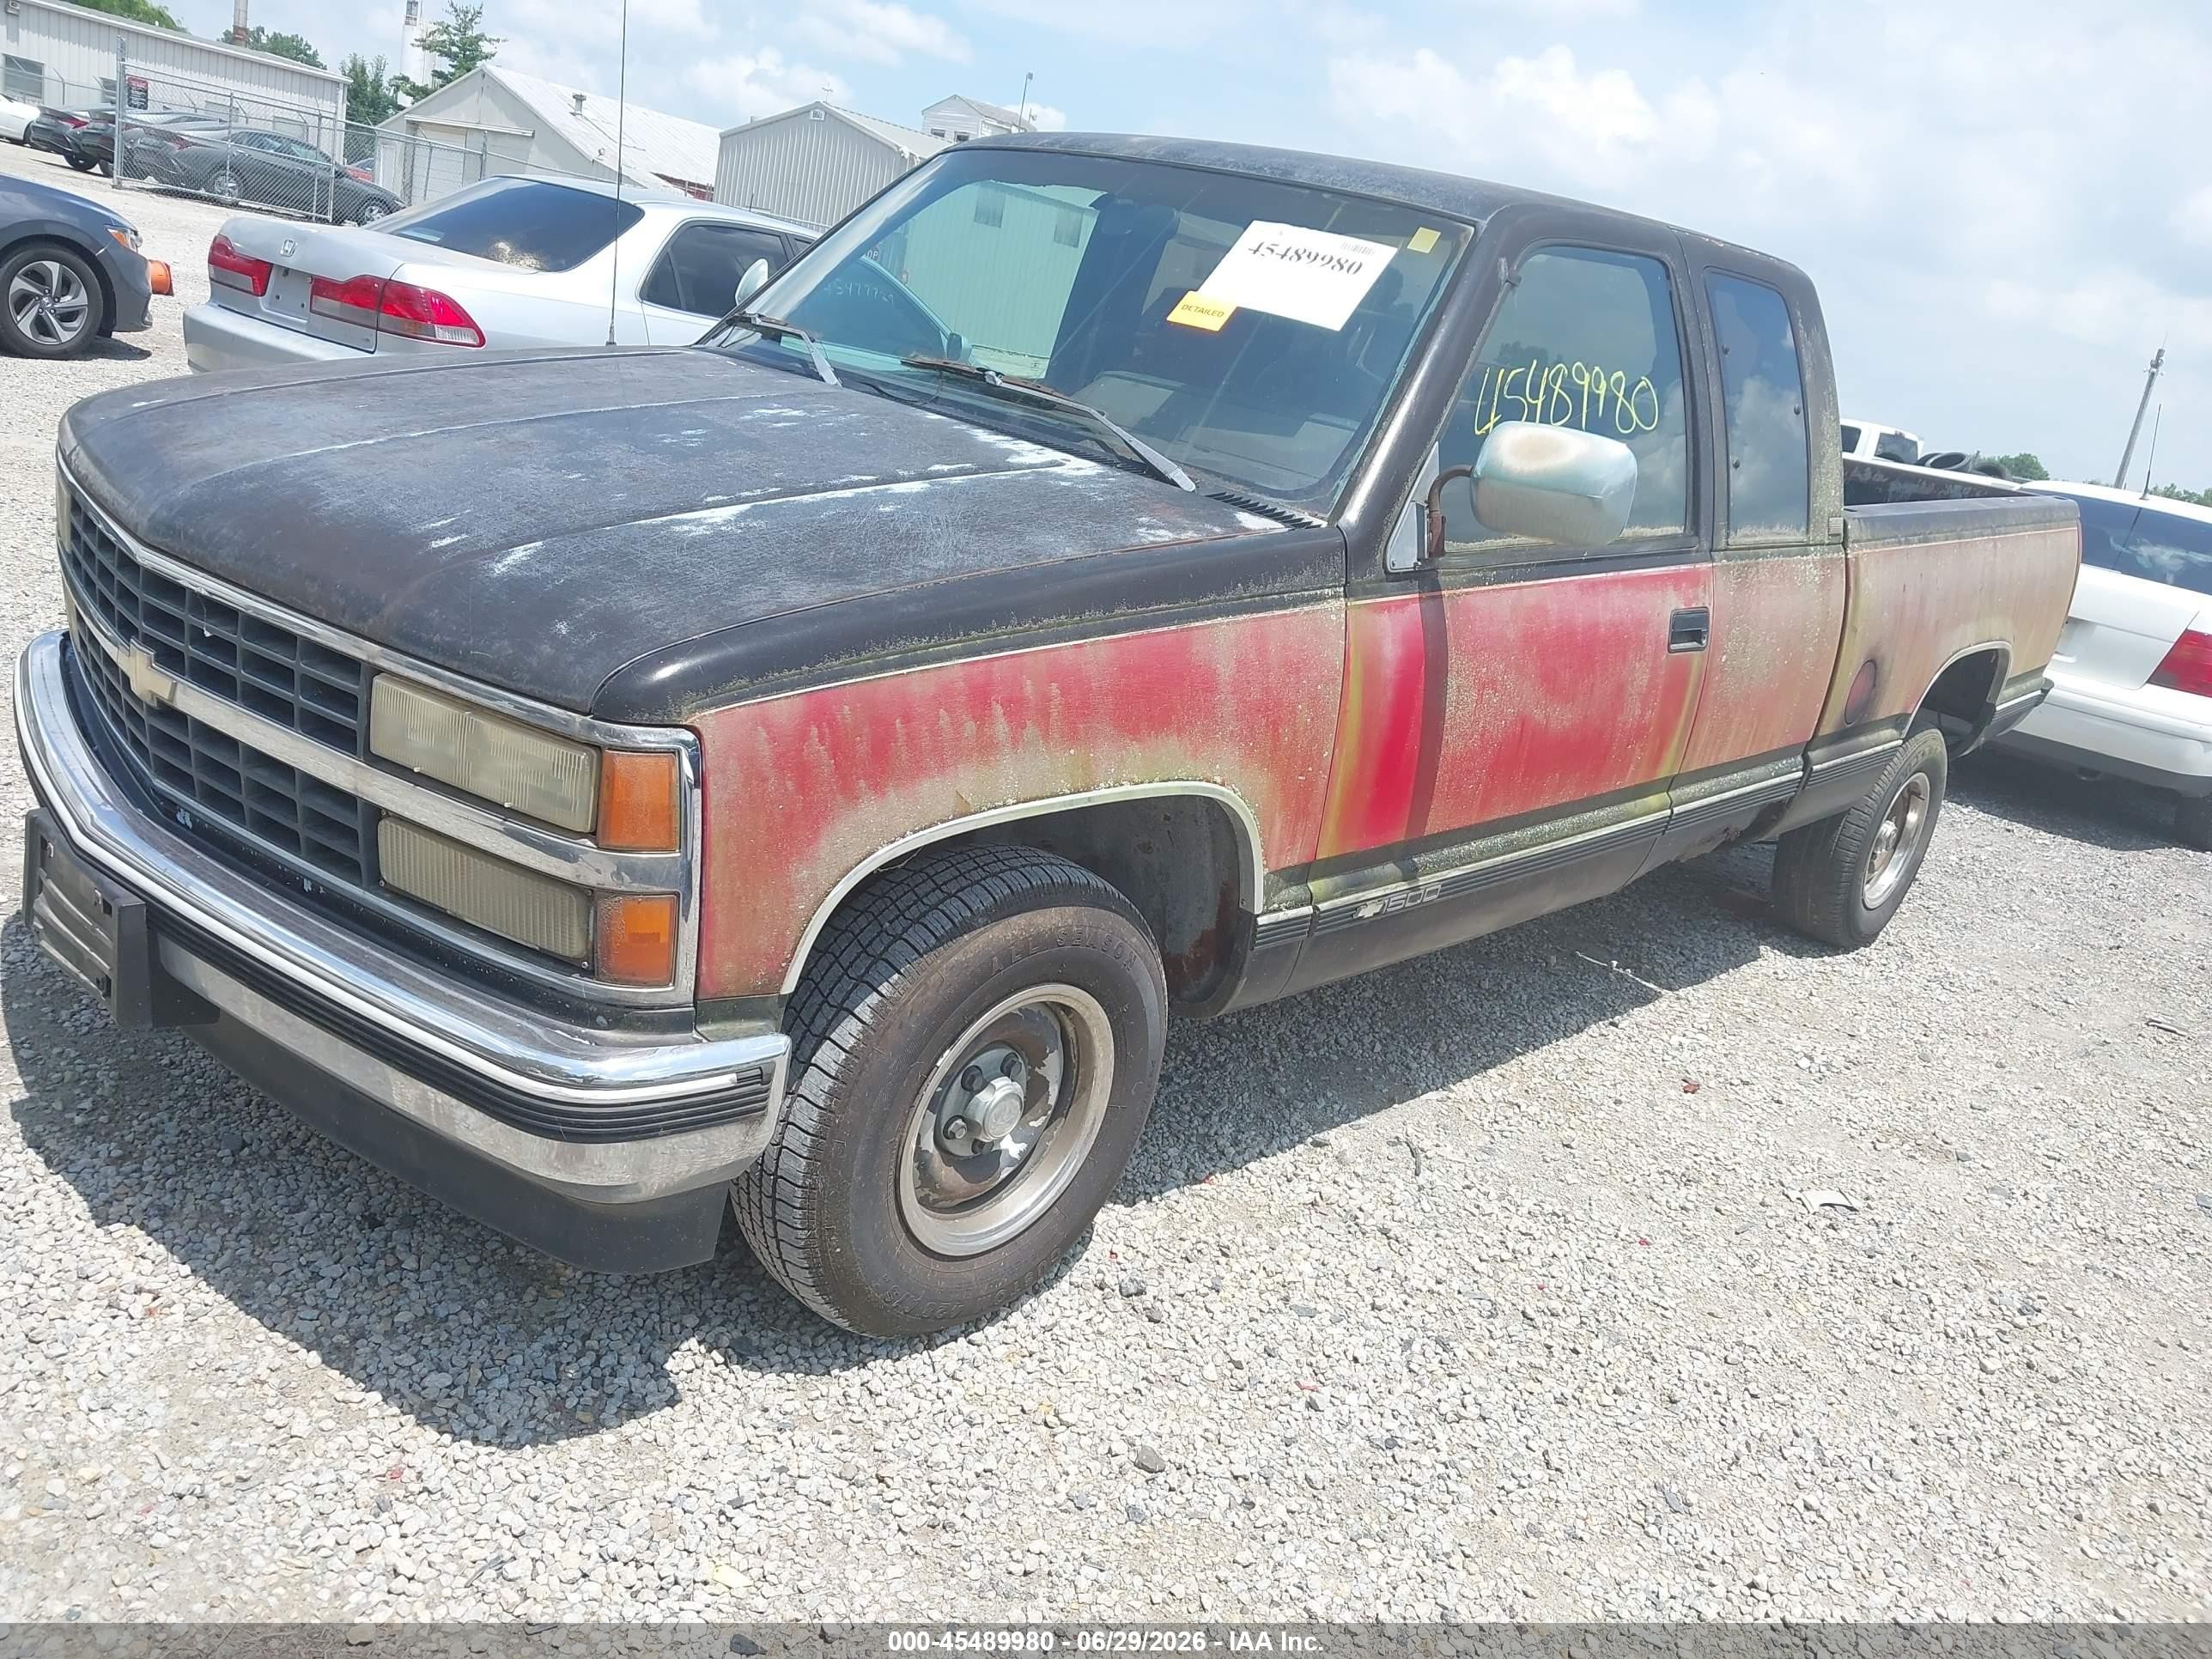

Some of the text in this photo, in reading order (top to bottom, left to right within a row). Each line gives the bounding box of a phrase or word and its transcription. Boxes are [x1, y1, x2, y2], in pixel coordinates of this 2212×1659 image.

[1248, 240, 1364, 276] 45489980
[1180, 303, 1225, 319] DETAILED
[1474, 359, 1659, 434] 45489980
[1382, 881, 1443, 915] 1500
